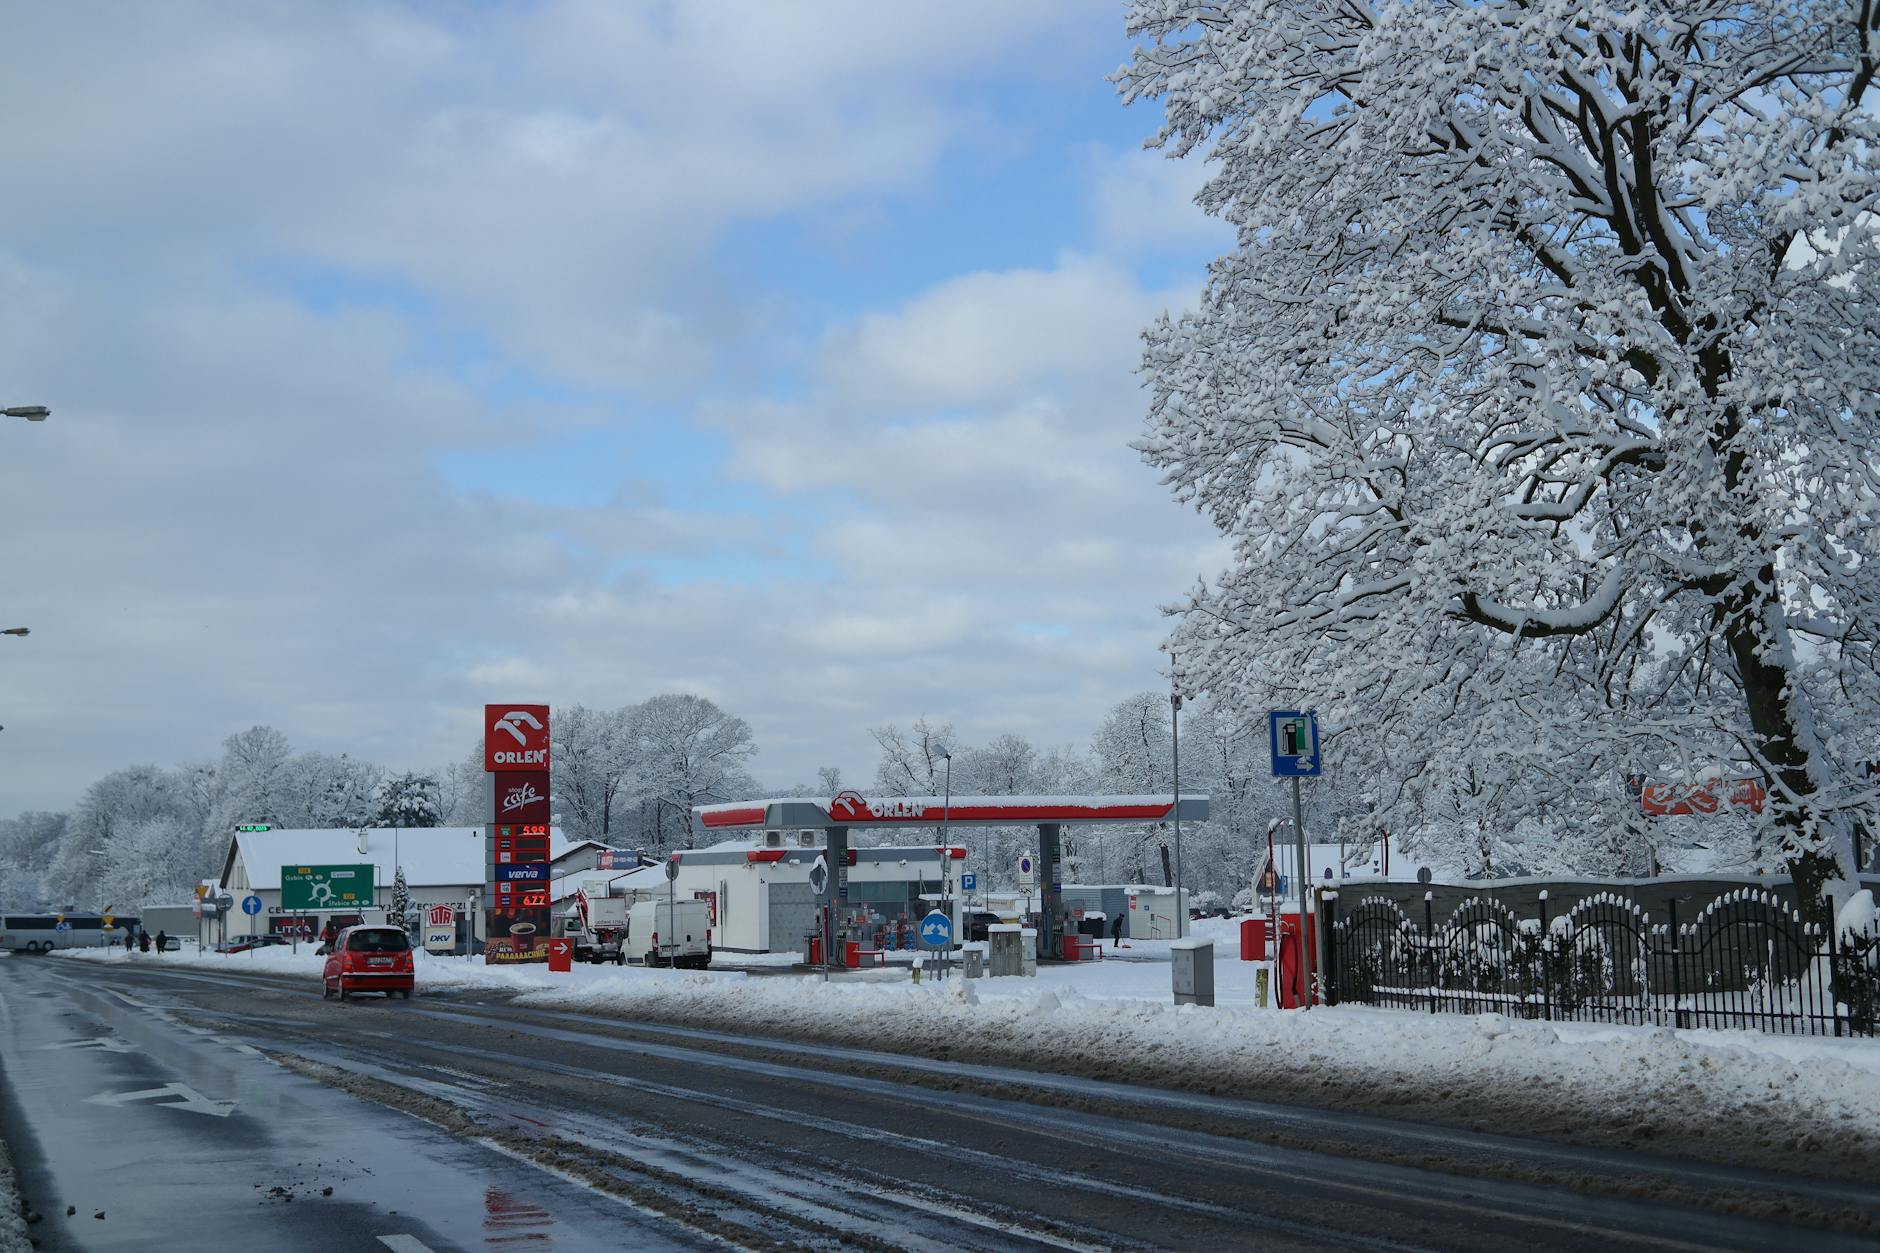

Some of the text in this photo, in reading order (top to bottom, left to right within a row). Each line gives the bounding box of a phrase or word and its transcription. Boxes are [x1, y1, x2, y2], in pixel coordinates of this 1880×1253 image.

[494, 750, 544, 764] ORLEN
[503, 782, 536, 810] cafe
[872, 801, 925, 818] ORLEN
[508, 870, 539, 879] verva
[964, 875, 974, 889] P
[430, 908, 453, 926] UTA
